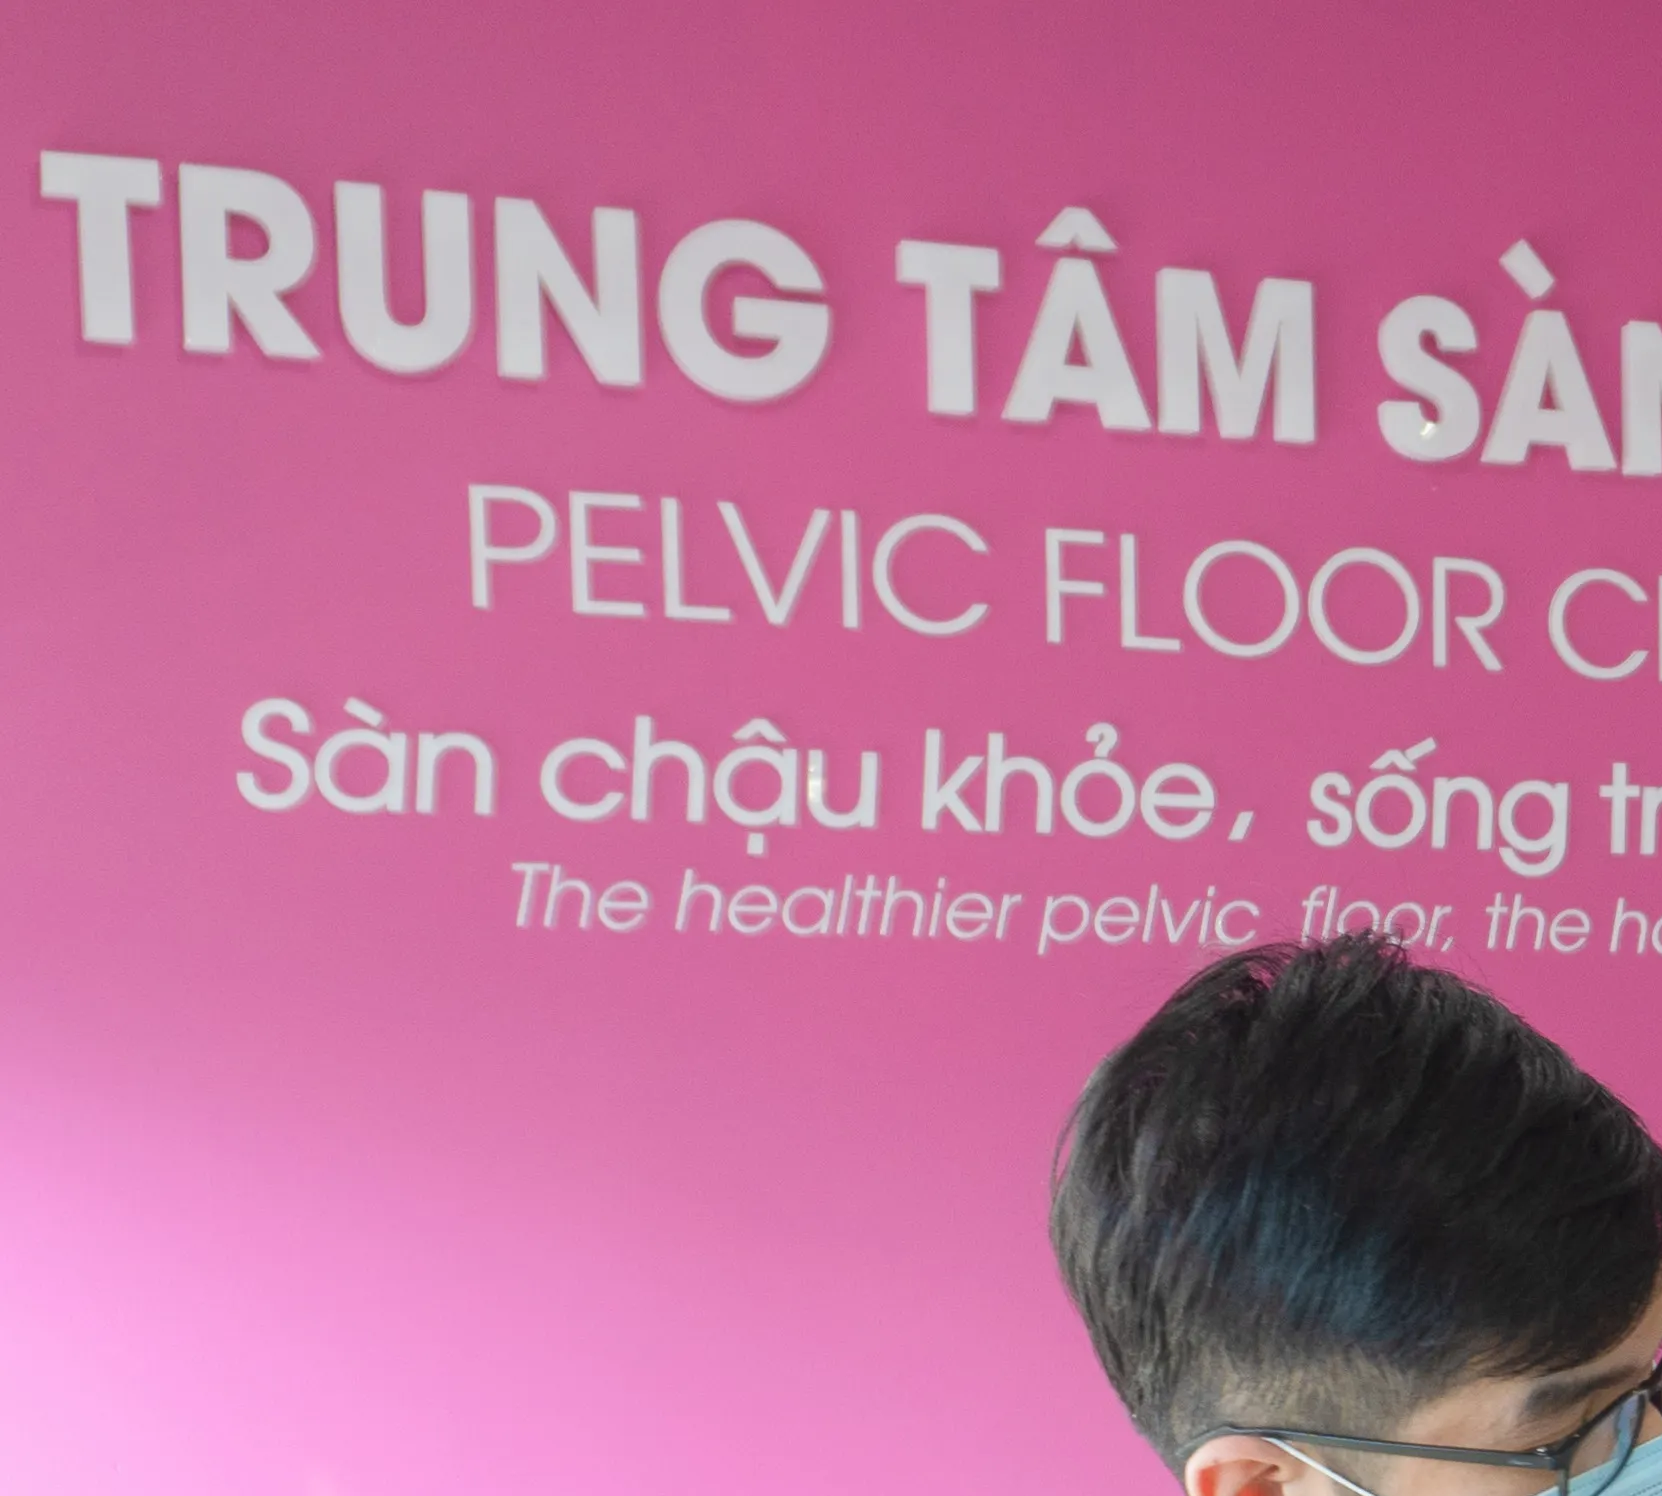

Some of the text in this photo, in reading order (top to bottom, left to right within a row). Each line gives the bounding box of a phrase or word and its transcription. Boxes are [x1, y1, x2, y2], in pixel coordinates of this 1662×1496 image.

[39, 149, 831, 404] TRUNG
[894, 206, 1316, 444] TÂM
[467, 482, 991, 637] PELVIC
[1043, 527, 1507, 673] FLOOR
[234, 695, 494, 816] Sàn
[539, 714, 880, 856] chậu
[920, 722, 1254, 844] khỏe,
[1305, 737, 1571, 878] sống
[511, 861, 650, 932] The
[675, 869, 1023, 942] healthier
[1038, 886, 1260, 955] pelvic
[1300, 885, 1455, 953] floor,
[1485, 892, 1591, 953] the
